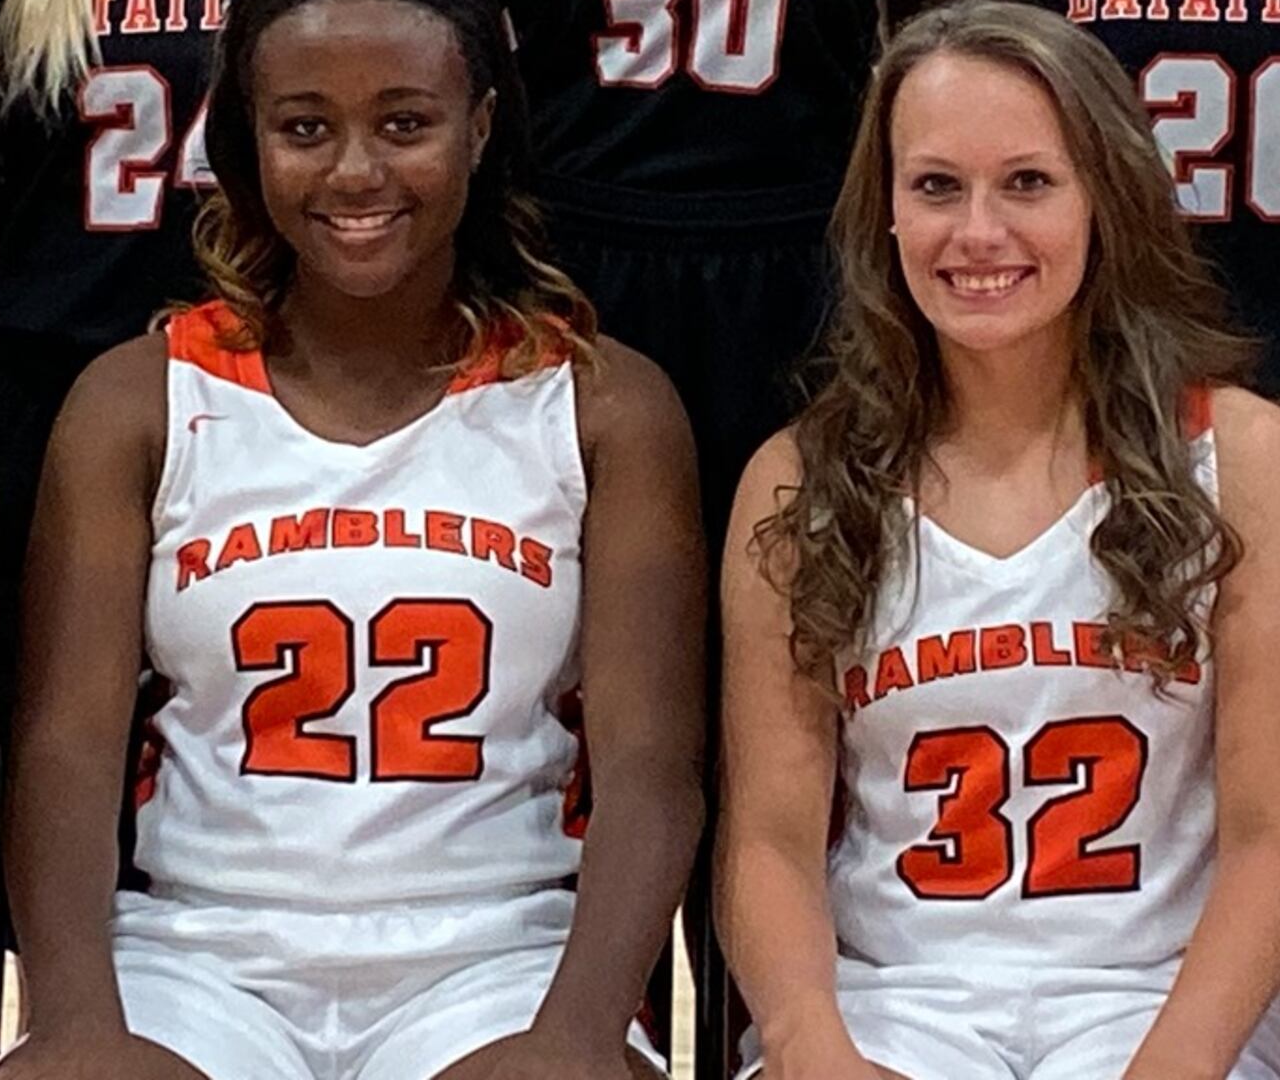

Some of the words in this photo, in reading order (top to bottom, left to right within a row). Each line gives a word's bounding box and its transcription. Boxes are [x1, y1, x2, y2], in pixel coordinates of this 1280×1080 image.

[176, 507, 555, 592] RAMBLERS
[231, 597, 493, 784] 22
[896, 714, 1149, 900] 32
